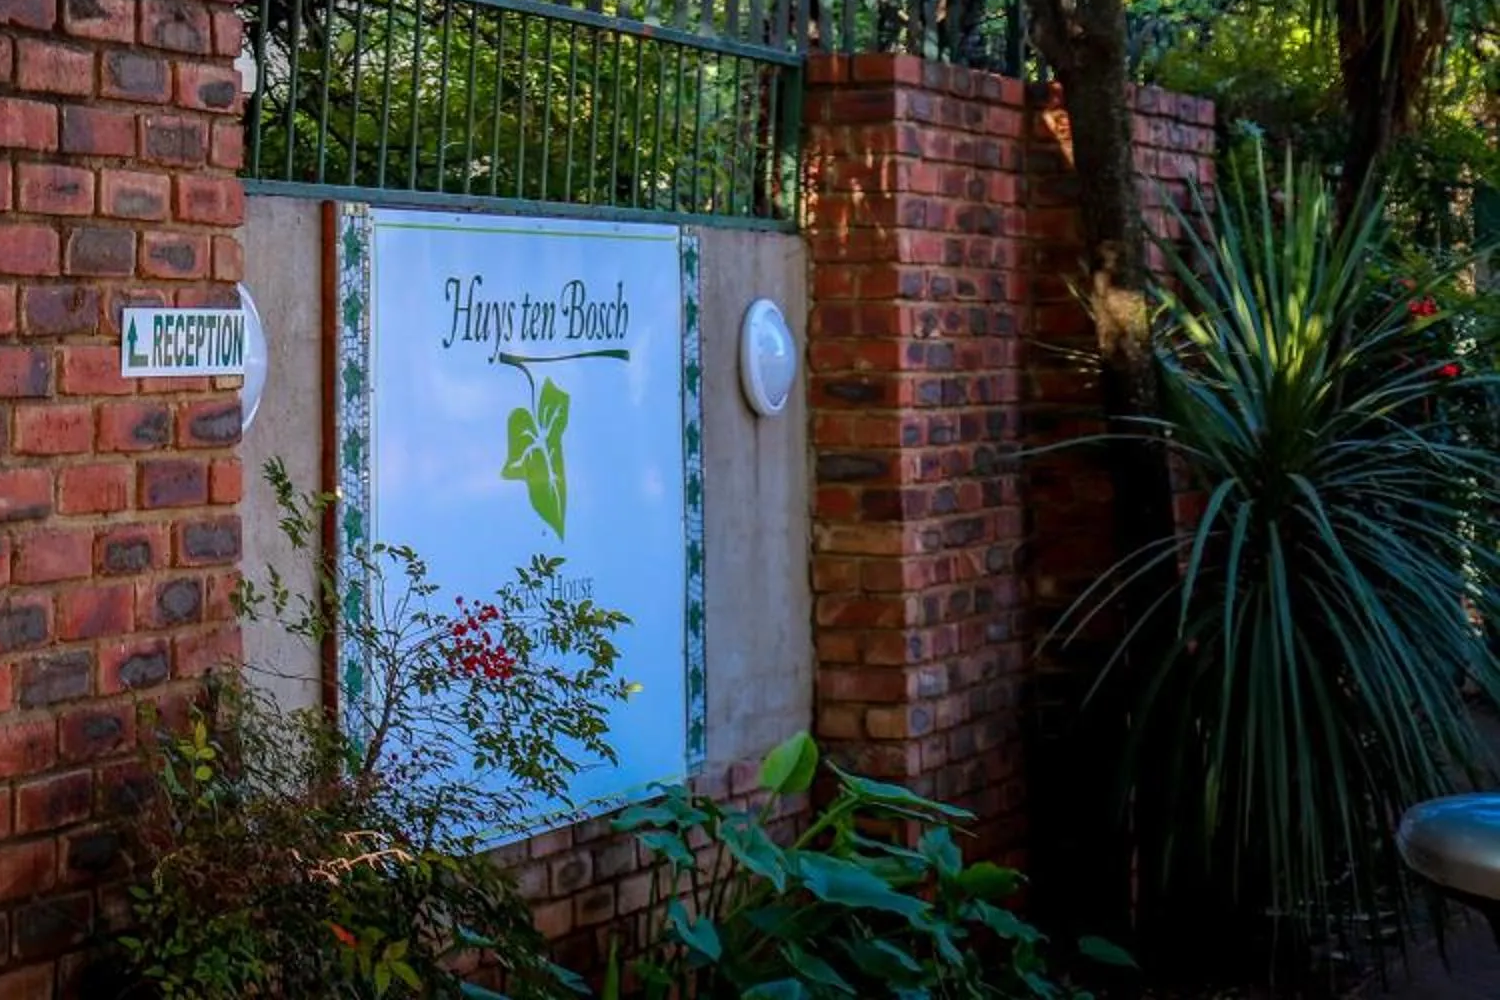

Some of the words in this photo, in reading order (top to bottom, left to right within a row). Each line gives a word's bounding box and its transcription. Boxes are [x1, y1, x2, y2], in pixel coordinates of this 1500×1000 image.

[152, 314, 245, 367] RECEPTION
[442, 274, 514, 364] Huys
[521, 292, 556, 341] ten
[561, 279, 630, 341] Bosch
